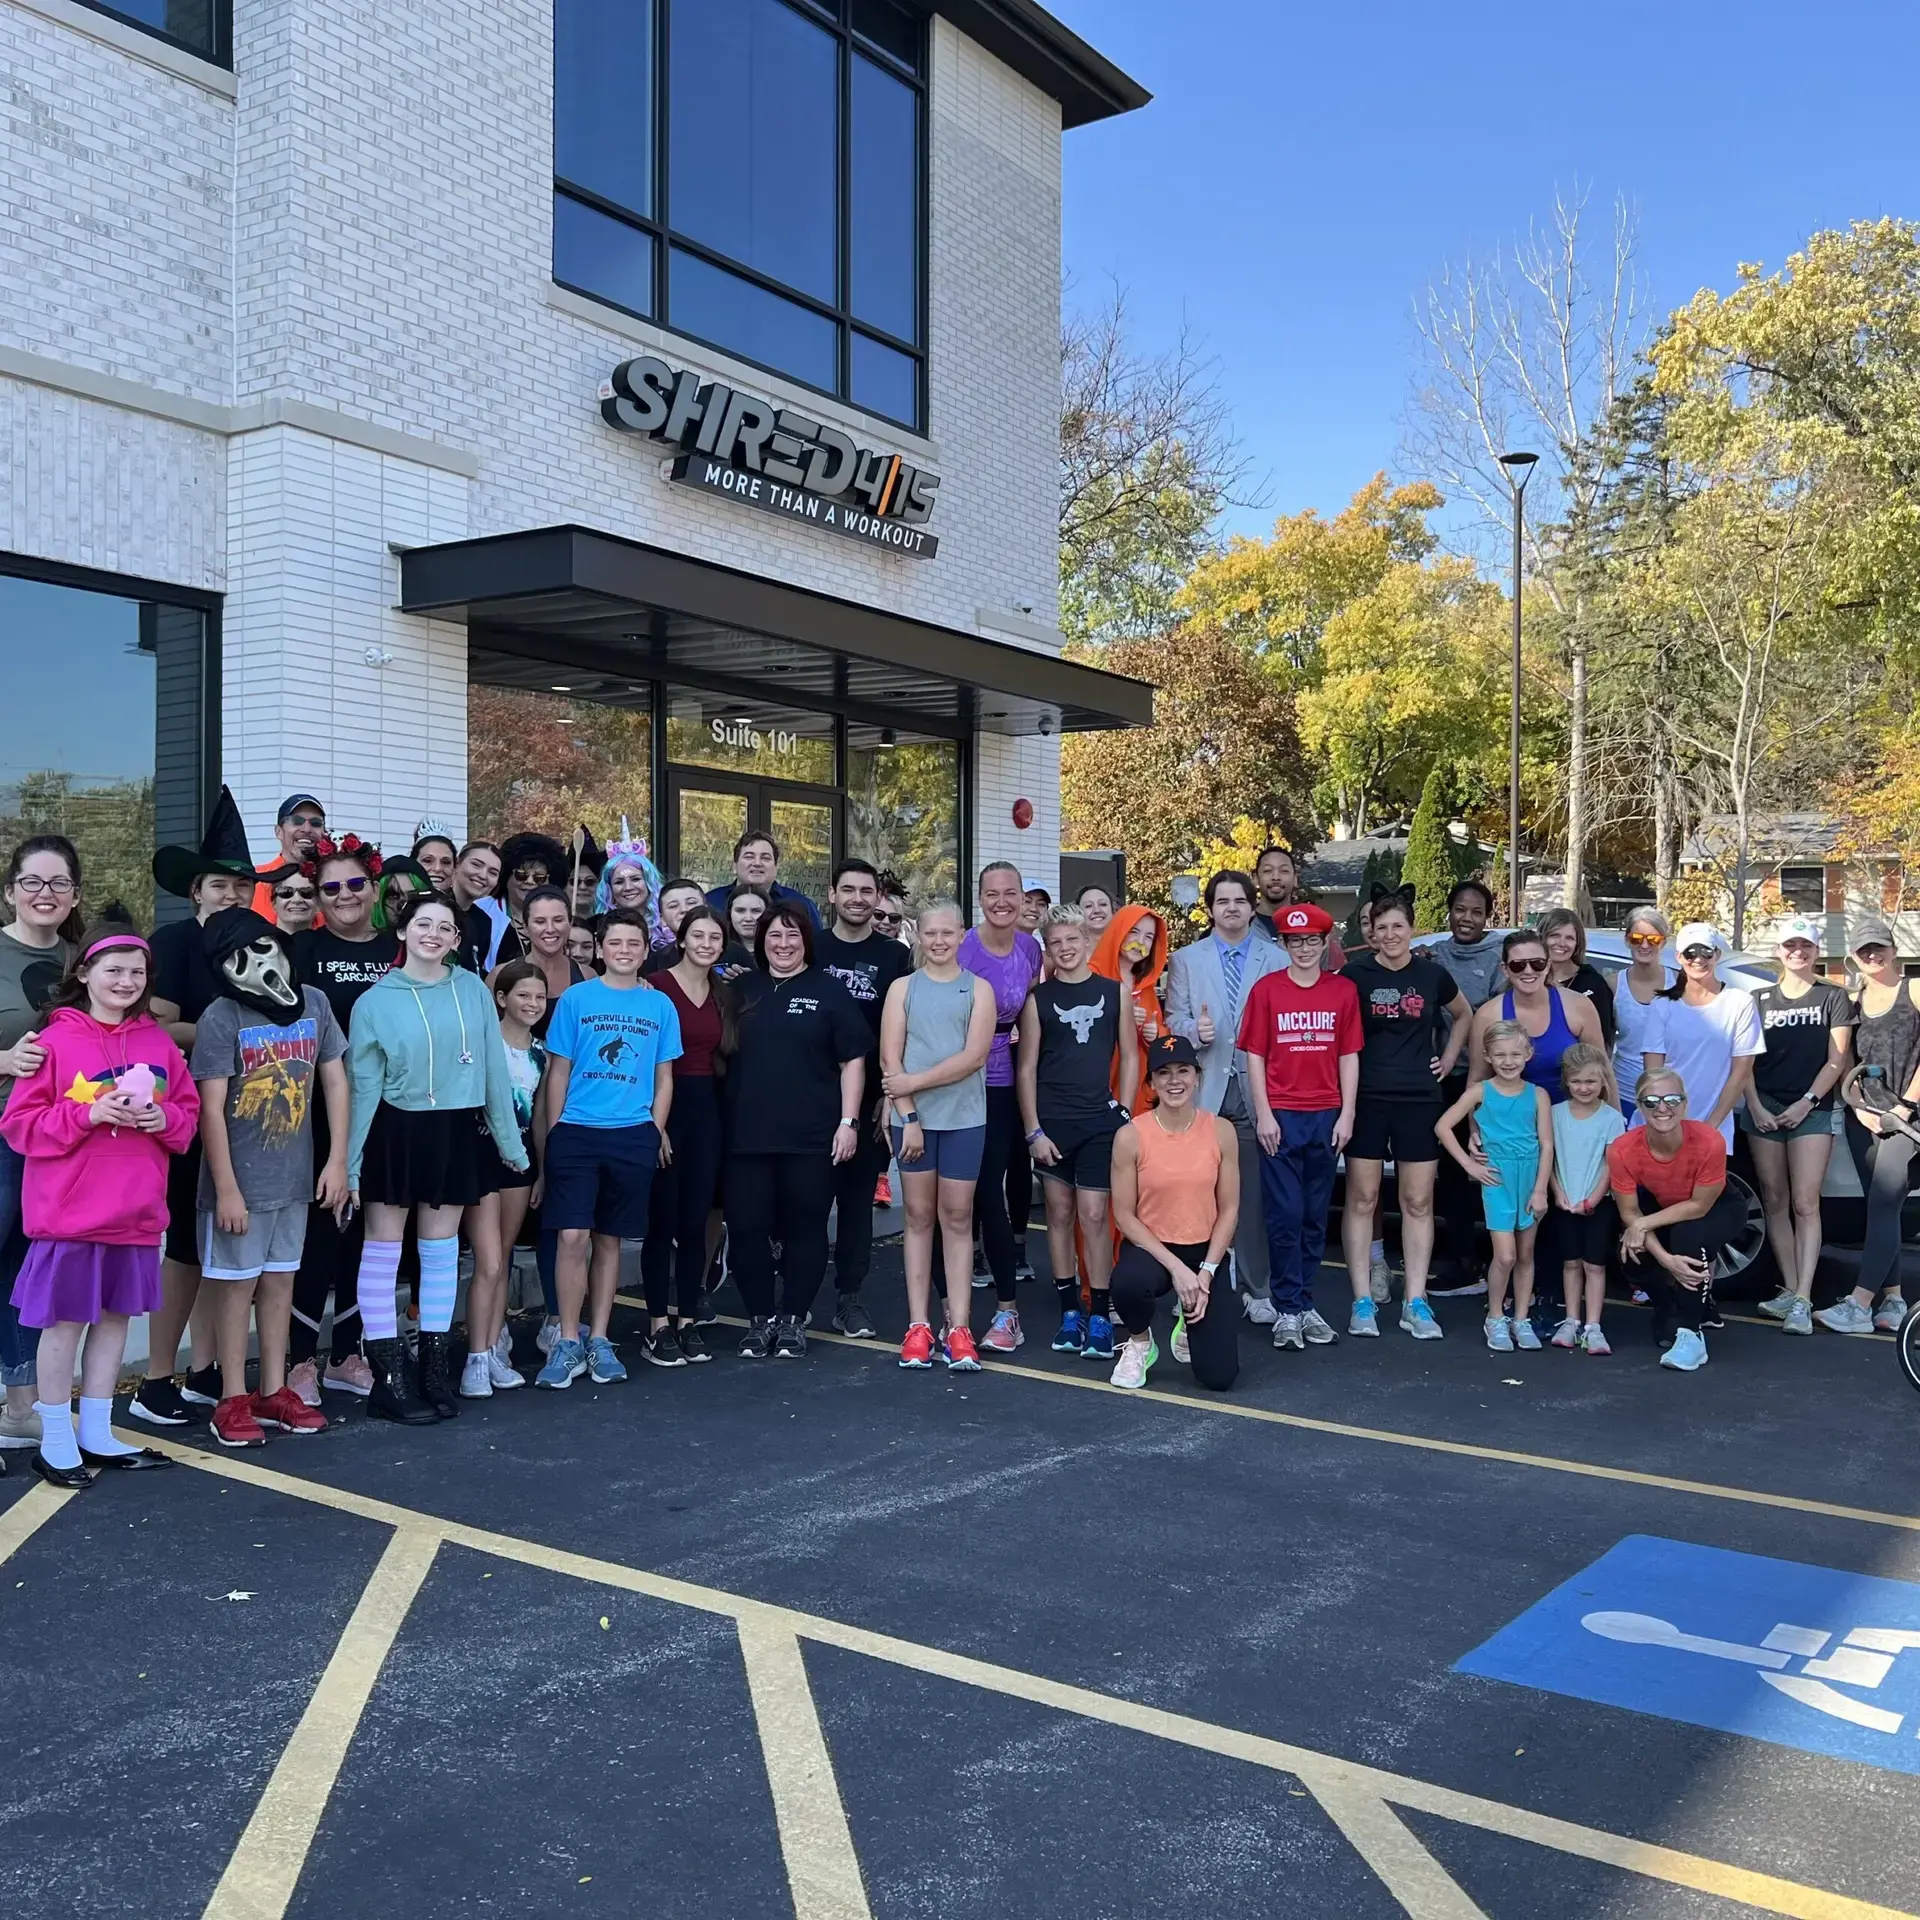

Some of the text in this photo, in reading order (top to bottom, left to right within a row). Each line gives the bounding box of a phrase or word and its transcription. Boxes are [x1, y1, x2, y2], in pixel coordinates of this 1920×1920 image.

[704, 463, 925, 552] MORE THAN A WORKOUT
[712, 719, 797, 755] Suite 101
[317, 961, 393, 973] I SPEAK FLU
[790, 997, 819, 1005] ACADEMY
[581, 1014, 660, 1031] NAPERVILLE NORTH
[1277, 1011, 1337, 1031] MCCLURE
[1763, 1012, 1821, 1029] SOUTH
[594, 1024, 649, 1036] DAWG POUND
